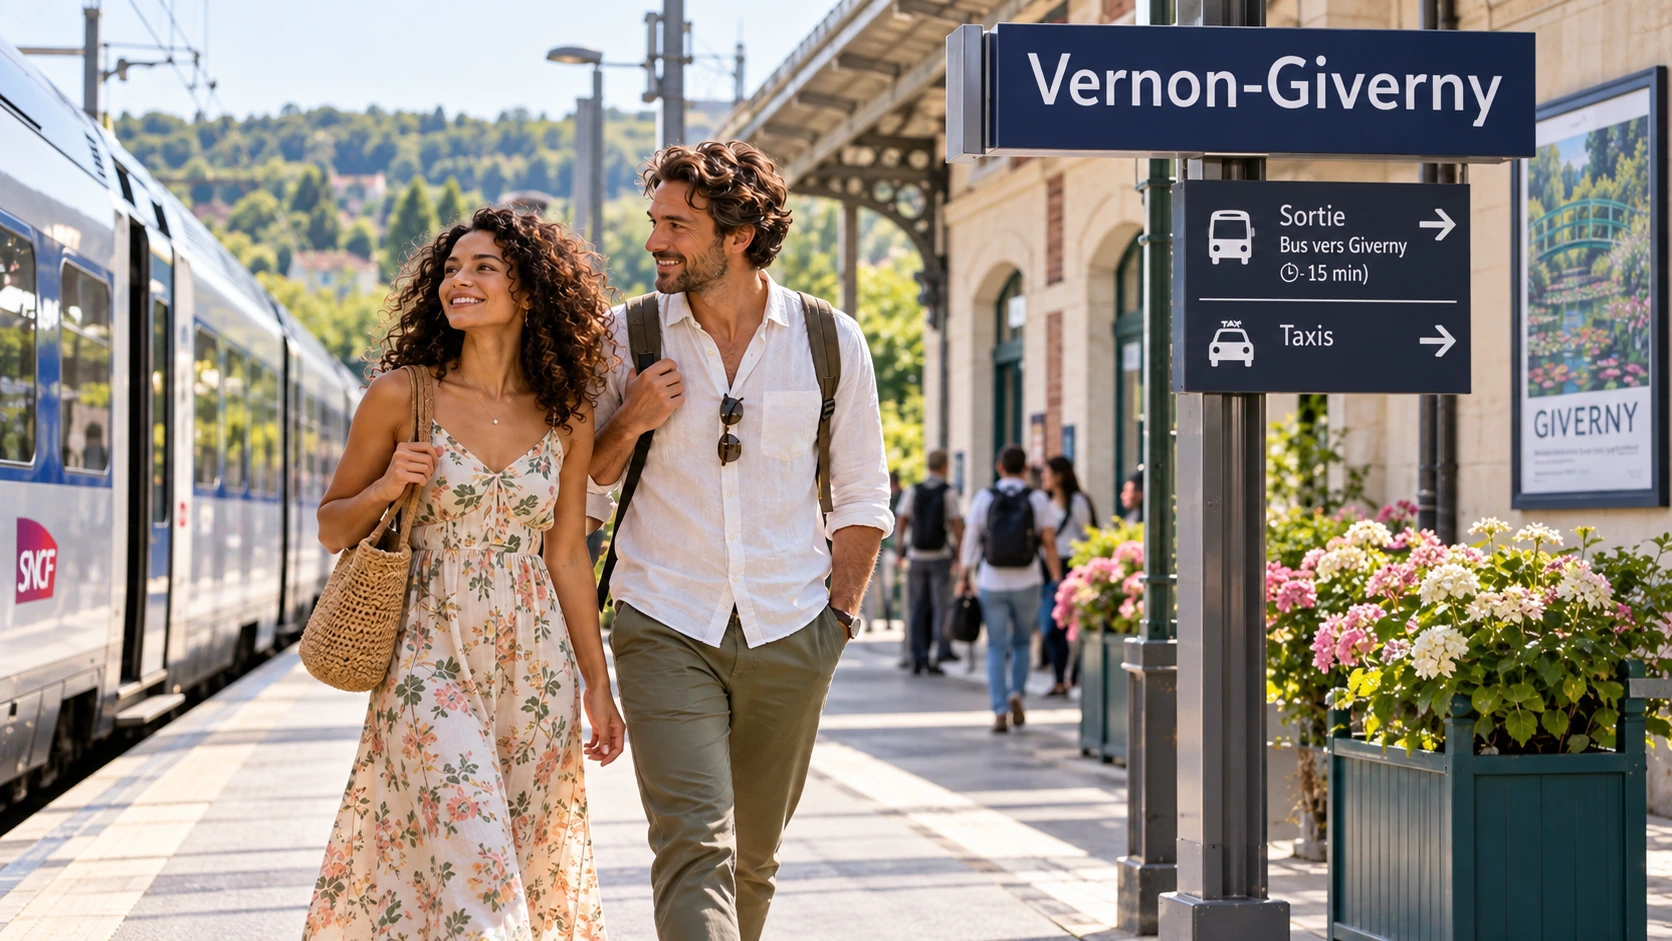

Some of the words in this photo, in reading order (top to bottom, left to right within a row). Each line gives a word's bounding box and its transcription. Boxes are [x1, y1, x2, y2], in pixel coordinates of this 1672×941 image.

[1027, 52, 1503, 128] Vernon-Giverny
[1279, 204, 1346, 227] Sortie
[1280, 235, 1308, 254] Bus
[1312, 240, 1345, 254] vers
[1348, 236, 1408, 259] Giverny
[1332, 263, 1369, 285] min)
[1279, 324, 1334, 347] Taxis
[1534, 401, 1638, 439] GIVERNY
[17, 548, 56, 593] SNCF
